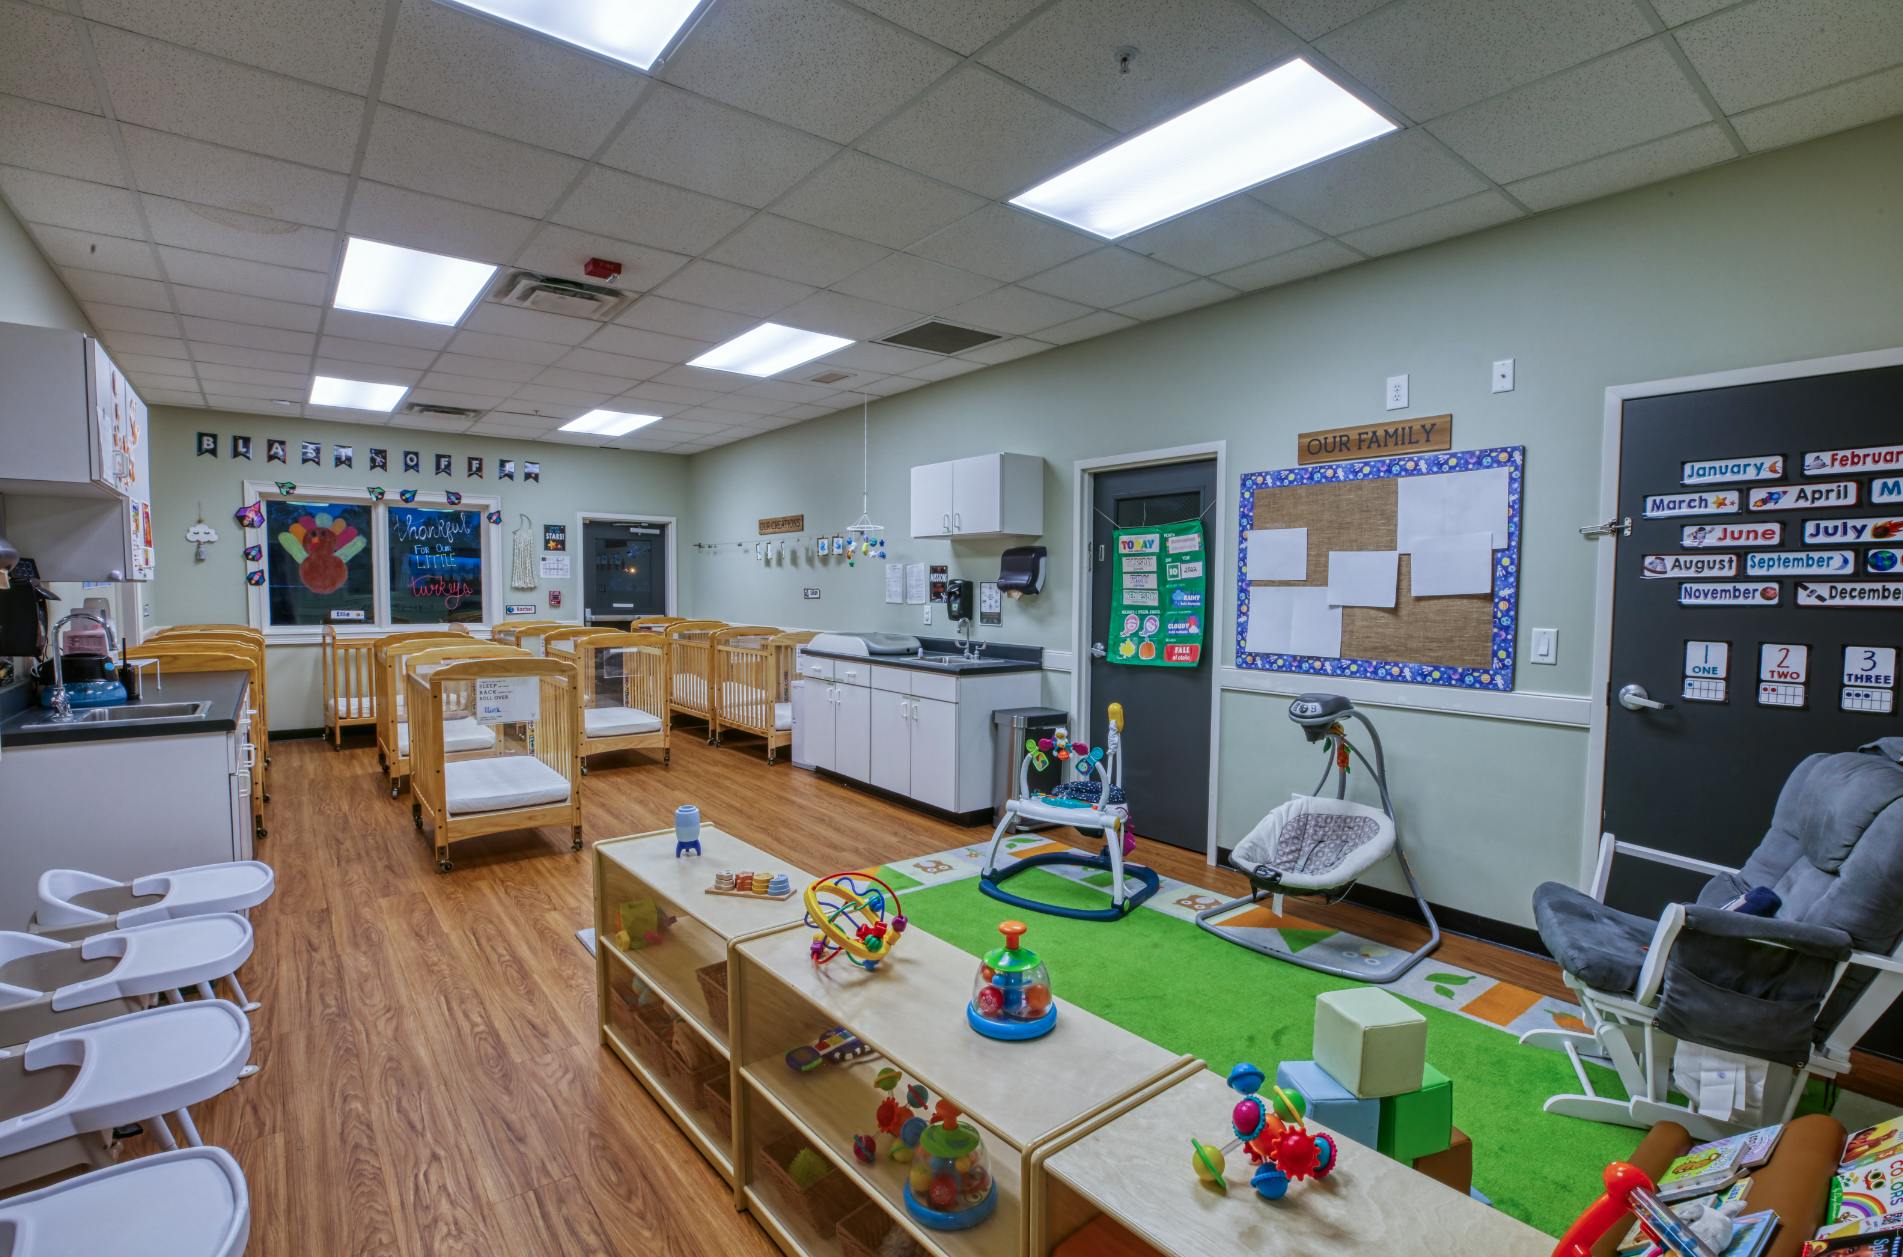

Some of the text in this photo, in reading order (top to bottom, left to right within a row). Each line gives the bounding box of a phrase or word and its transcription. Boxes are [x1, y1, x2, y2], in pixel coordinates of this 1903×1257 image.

[1307, 423, 1437, 455] OUR FAMILY
[1687, 462, 1765, 478] January
[1794, 484, 1848, 505] April
[1651, 496, 1708, 512] March
[1718, 527, 1776, 542] June
[1808, 522, 1868, 540] July
[1671, 558, 1734, 573] August
[1750, 554, 1834, 571] September
[1169, 567, 1178, 576] 10
[1683, 586, 1759, 600] November
[1829, 585, 1903, 601] Decembe
[1705, 645, 1709, 664] 1
[1777, 648, 1790, 669] 2
[1860, 650, 1877, 672] 3
[1692, 665, 1719, 675] ONE
[1769, 670, 1800, 680] TWO
[1846, 673, 1892, 684] THREE
